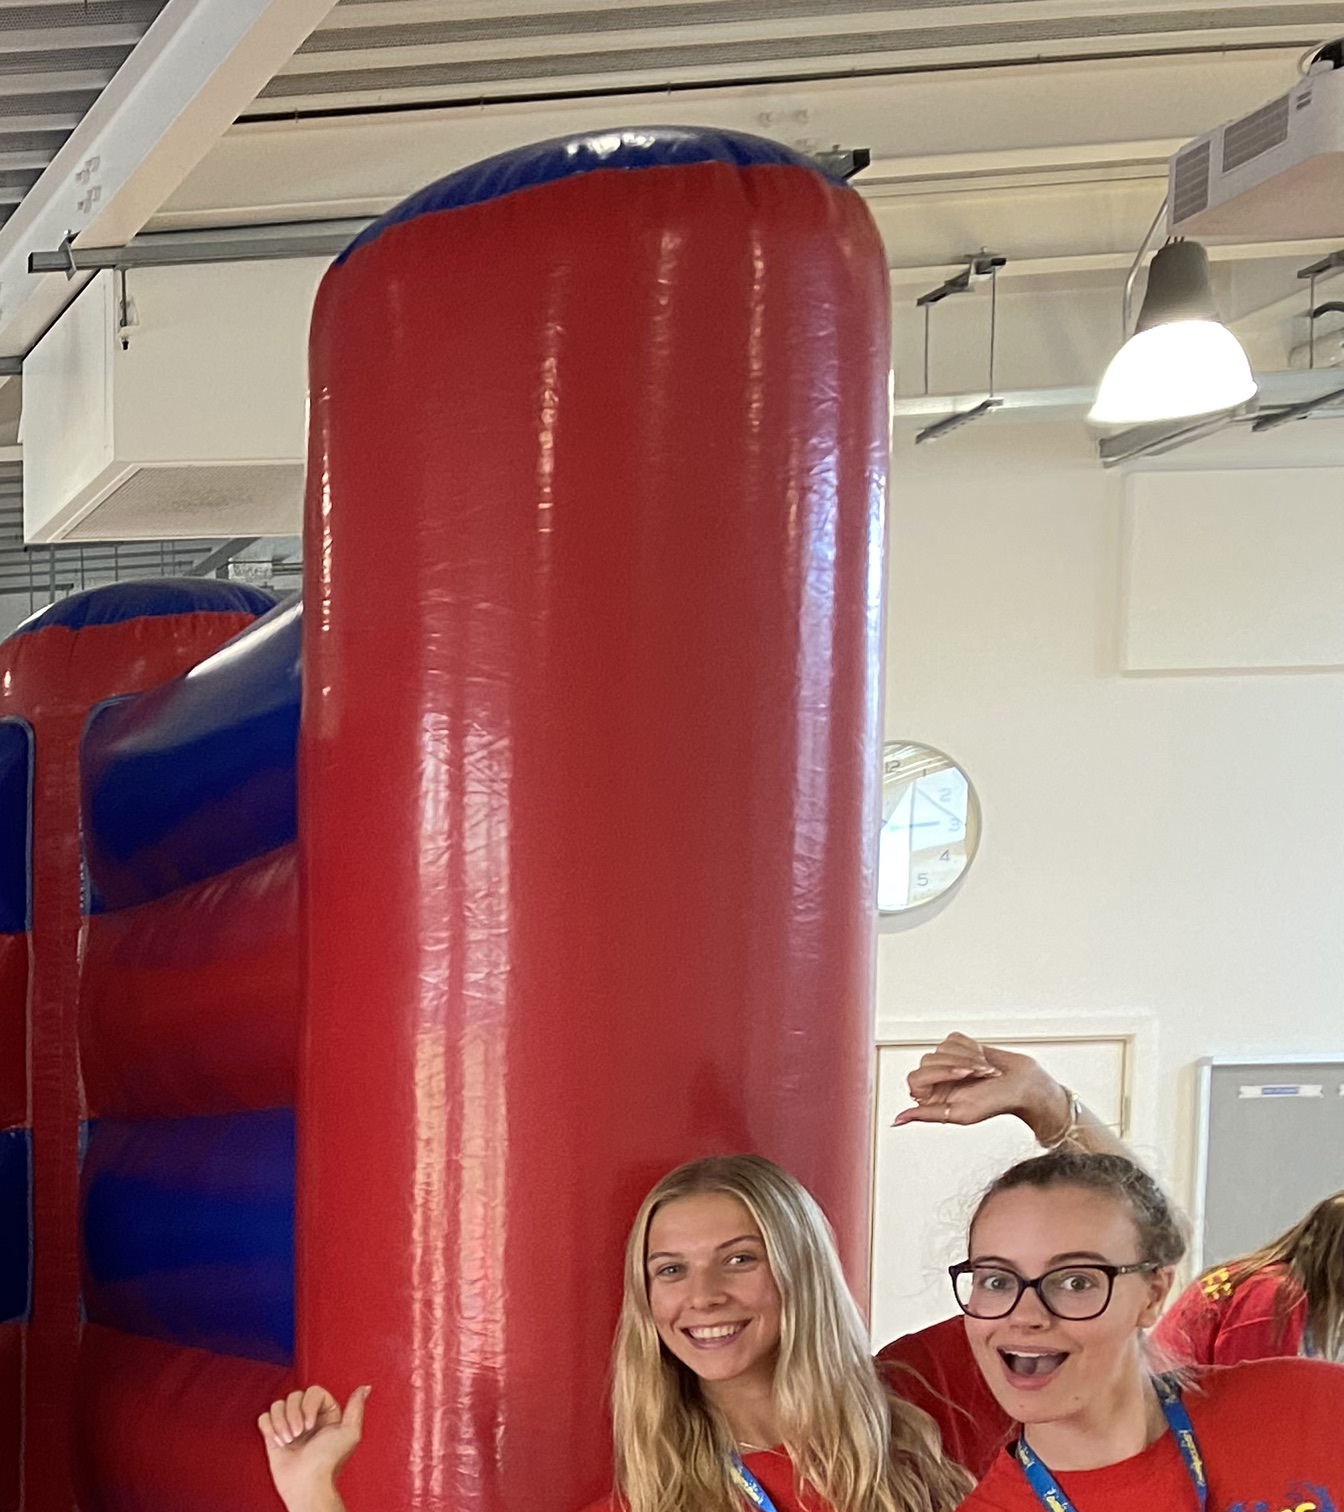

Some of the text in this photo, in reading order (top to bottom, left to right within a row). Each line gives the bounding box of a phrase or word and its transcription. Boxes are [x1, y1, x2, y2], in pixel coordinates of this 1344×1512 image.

[939, 788, 952, 802] 2
[948, 817, 963, 833] 3
[939, 849, 951, 862] 4
[917, 873, 929, 887] 5
